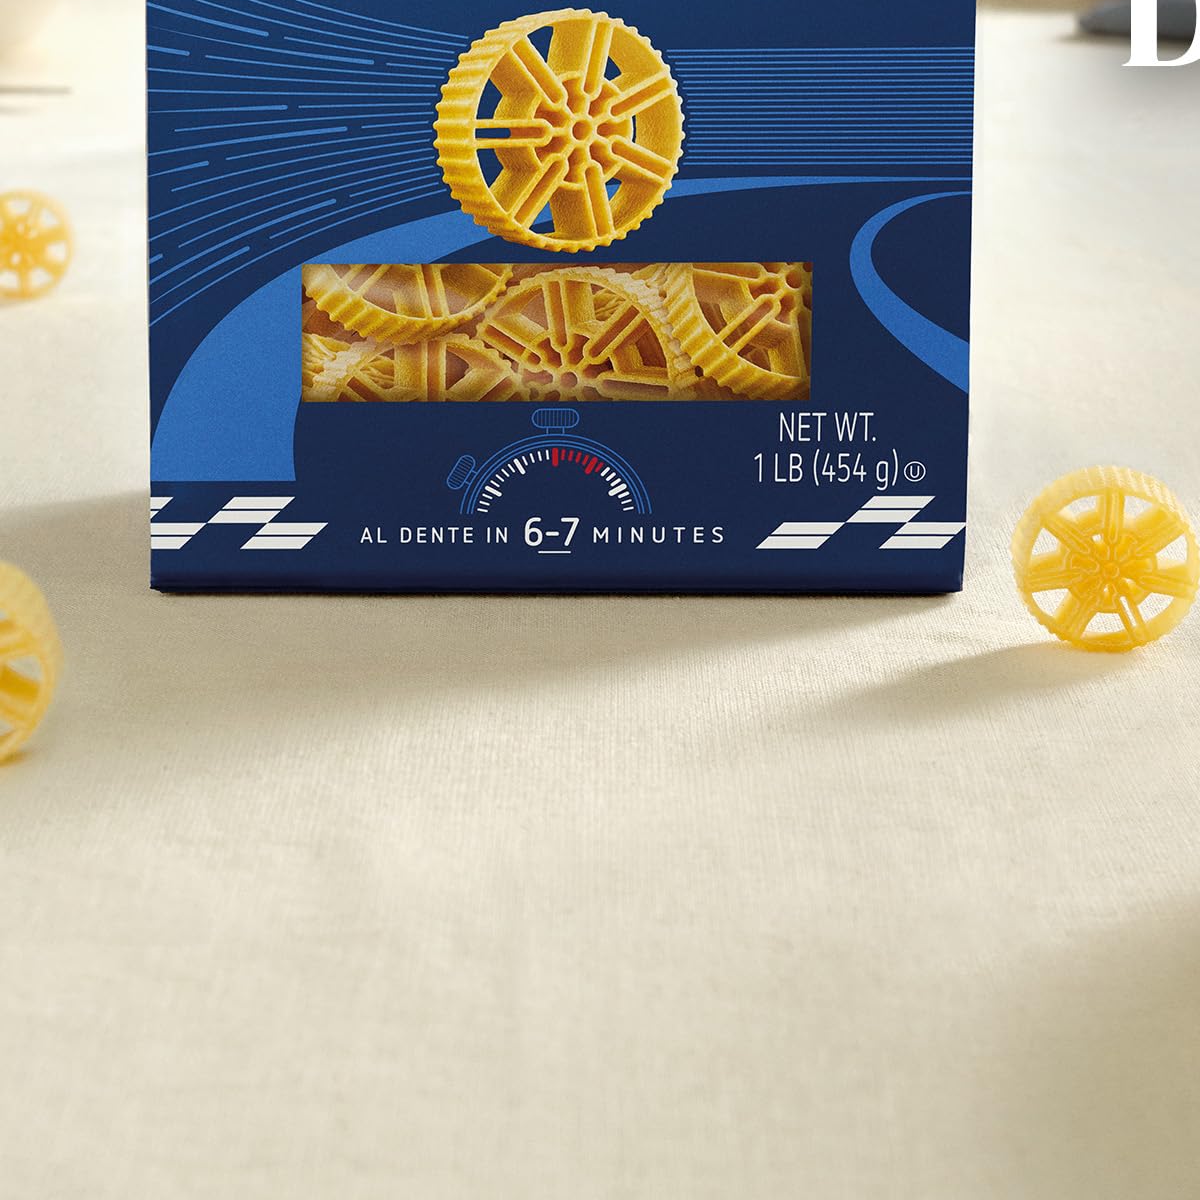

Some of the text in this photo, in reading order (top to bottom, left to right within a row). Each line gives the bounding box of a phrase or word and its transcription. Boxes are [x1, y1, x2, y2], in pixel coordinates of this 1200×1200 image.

[779, 411, 877, 442] NET WT.
[753, 452, 763, 483] 1
[773, 452, 803, 483] LB
[812, 448, 868, 487] (454
[875, 448, 899, 491] g)
[360, 526, 388, 544] AL
[400, 526, 475, 544] DENTE
[485, 526, 509, 544] IN
[592, 526, 725, 544] MINUTES
